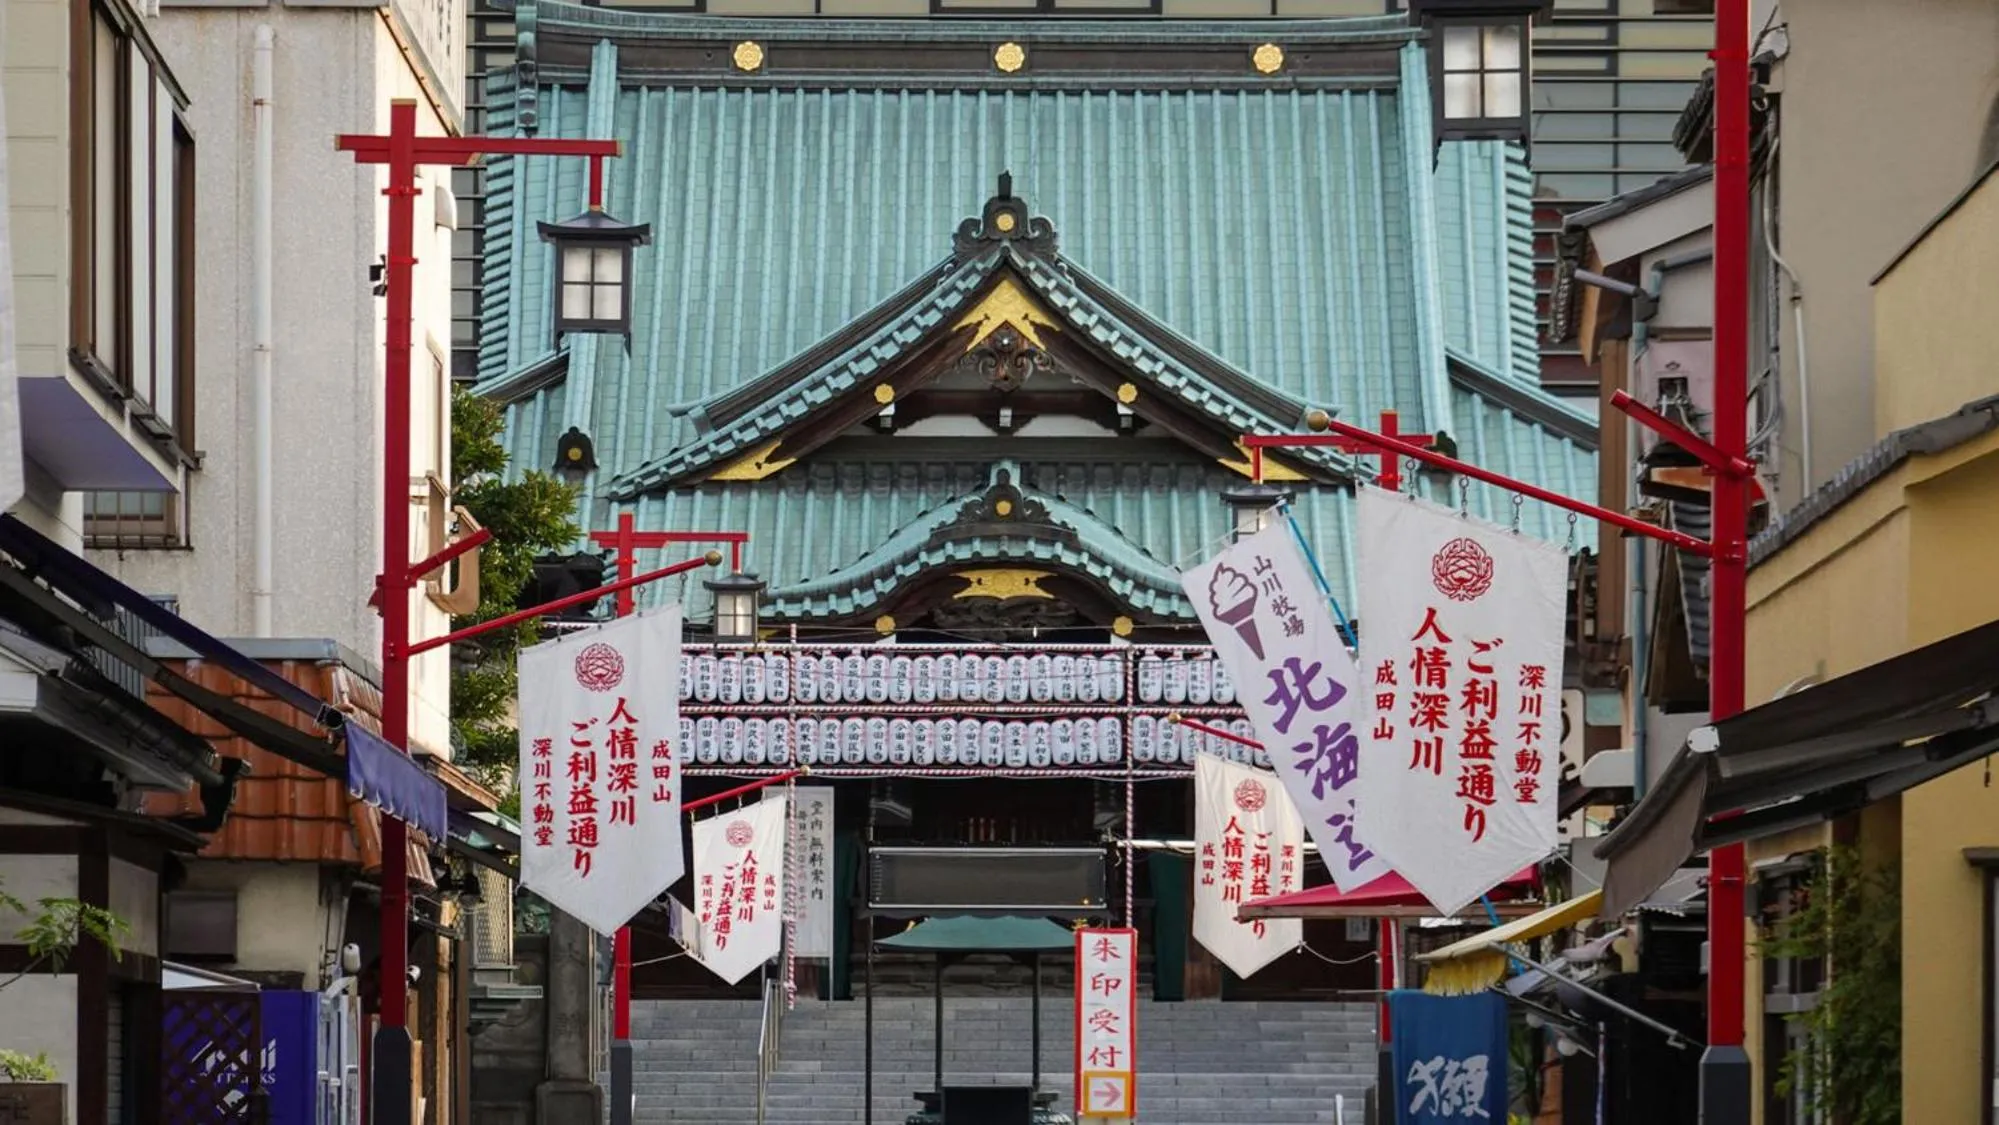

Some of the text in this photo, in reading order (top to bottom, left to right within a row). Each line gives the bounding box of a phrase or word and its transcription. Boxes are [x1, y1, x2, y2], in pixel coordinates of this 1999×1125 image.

[1253, 556, 1306, 638] 山川牧場
[1374, 660, 1398, 741] 成田山
[1409, 607, 1453, 776] 人情深川
[1456, 638, 1503, 843] ご利益通り
[1513, 664, 1547, 803] 深川不動堂
[531, 738, 554, 846] 深川不動堂
[566, 718, 600, 878] ご利益通り
[606, 697, 639, 826] 人情深川
[652, 740, 672, 803] 成田山
[713, 862, 740, 951] ご利益通り
[737, 849, 758, 923] 人情深川
[763, 873, 777, 912] 成田山
[1202, 841, 1216, 887] 成田山
[1222, 816, 1245, 904] 人情深川
[1250, 831, 1273, 939] ご利益り
[1087, 937, 1122, 1068] 朱印受付
